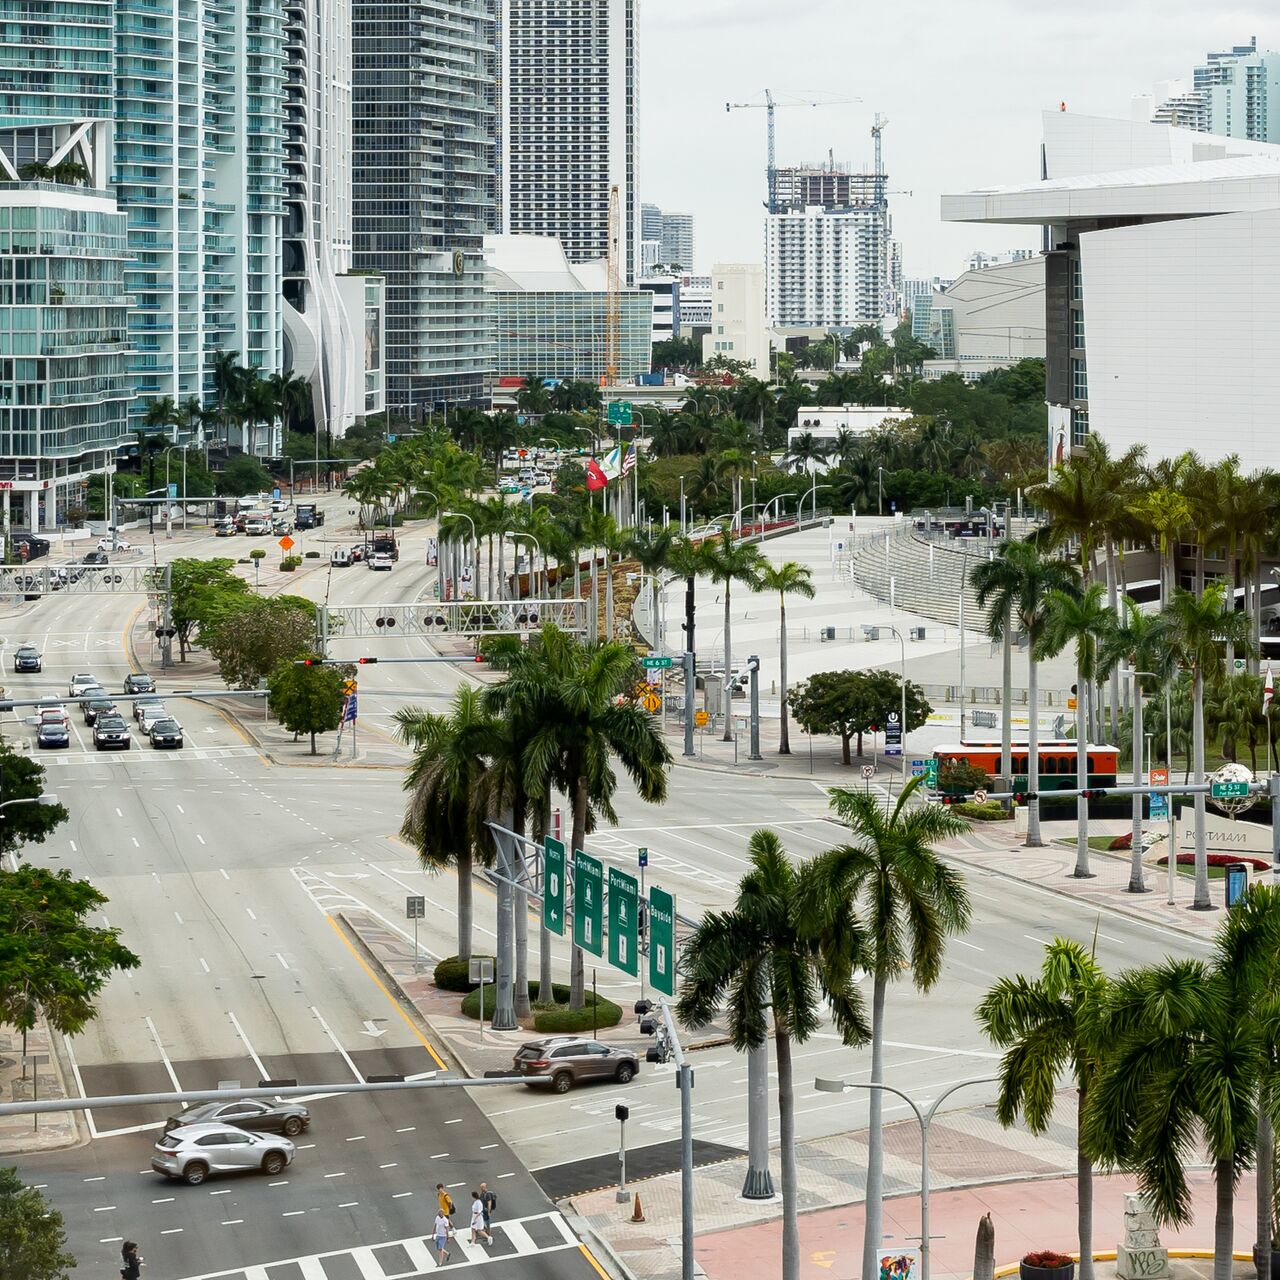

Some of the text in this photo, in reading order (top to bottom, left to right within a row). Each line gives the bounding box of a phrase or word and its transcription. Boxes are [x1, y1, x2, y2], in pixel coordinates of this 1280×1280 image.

[577, 857, 601, 877] PortMiami
[611, 874, 636, 895] PortMiami
[651, 904, 671, 924] Bayside
